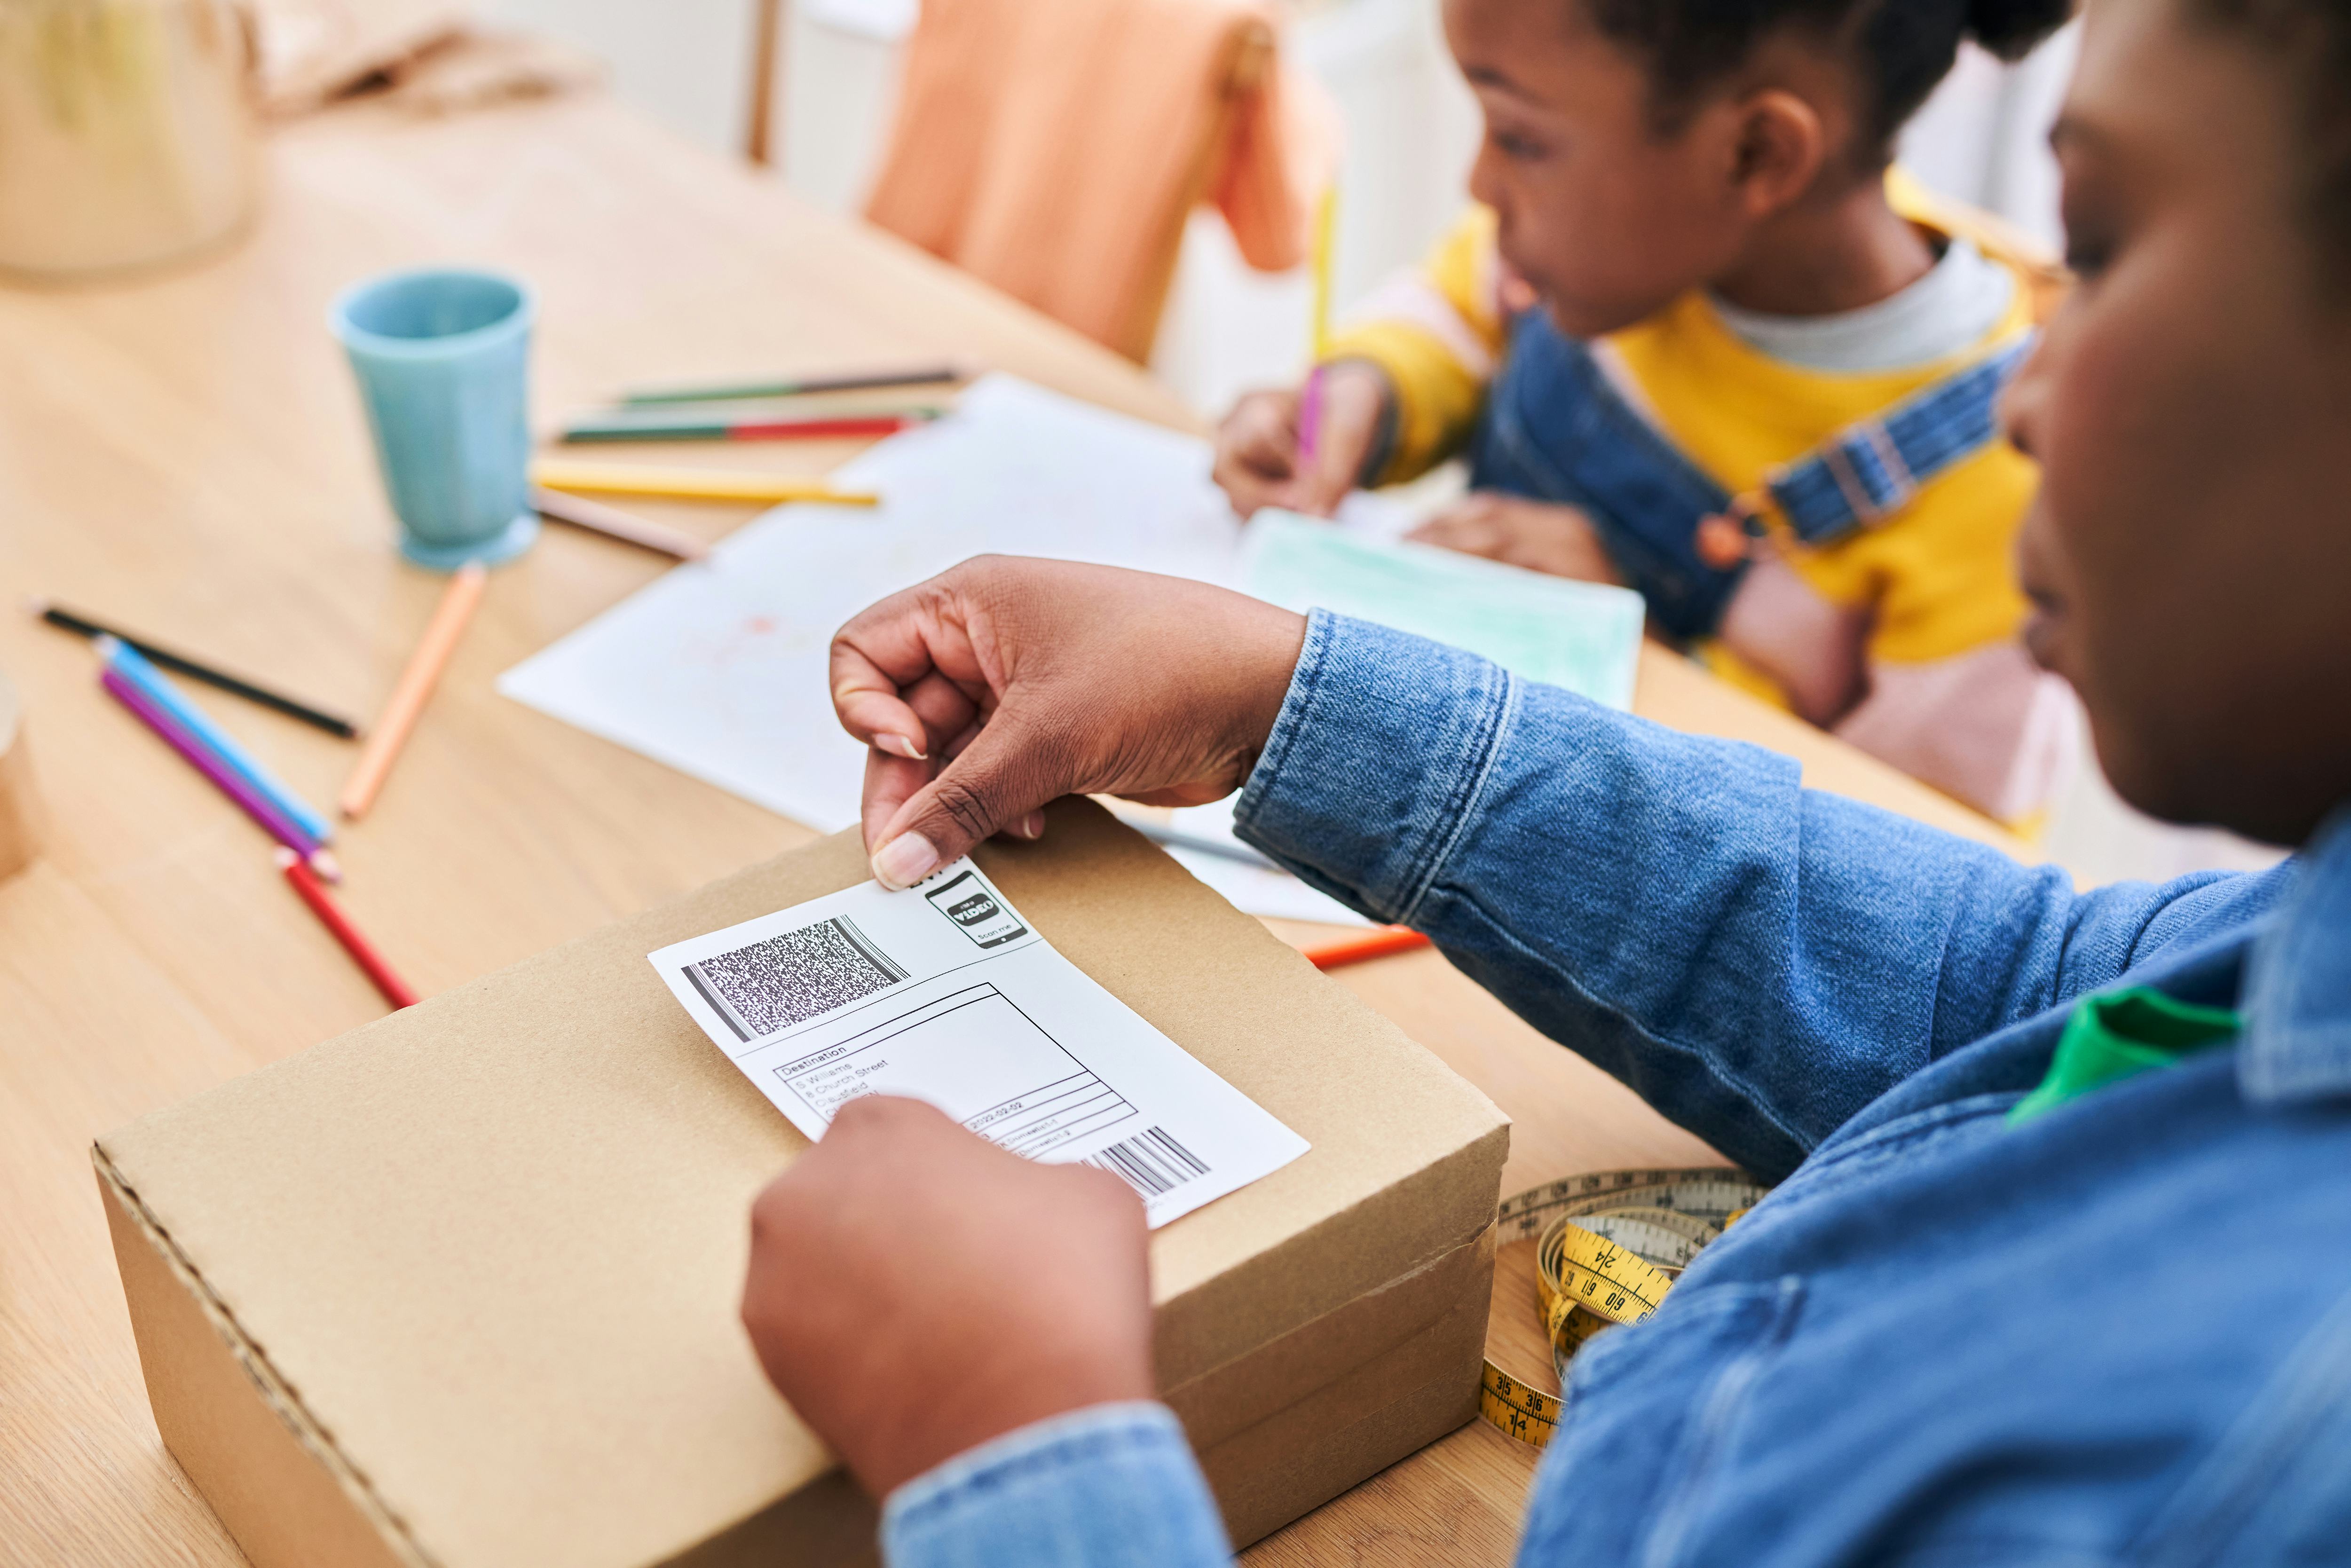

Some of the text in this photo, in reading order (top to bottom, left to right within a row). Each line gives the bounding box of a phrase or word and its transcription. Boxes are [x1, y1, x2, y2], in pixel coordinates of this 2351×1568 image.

[954, 900, 994, 922] VIDEO
[978, 924, 1012, 939] Scan me
[781, 1046, 846, 1076] Destination
[806, 1063, 852, 1084] Williams
[815, 1075, 855, 1094] Church
[855, 1060, 888, 1077] Street
[970, 1101, 1024, 1129] 2022-02-02
[1595, 1251, 1616, 1268] 24
[1581, 1279, 1597, 1296] 61
[1605, 1292, 1625, 1311] 60
[1497, 1376, 1543, 1412] 35 36
[1509, 1414, 1526, 1431] 14
